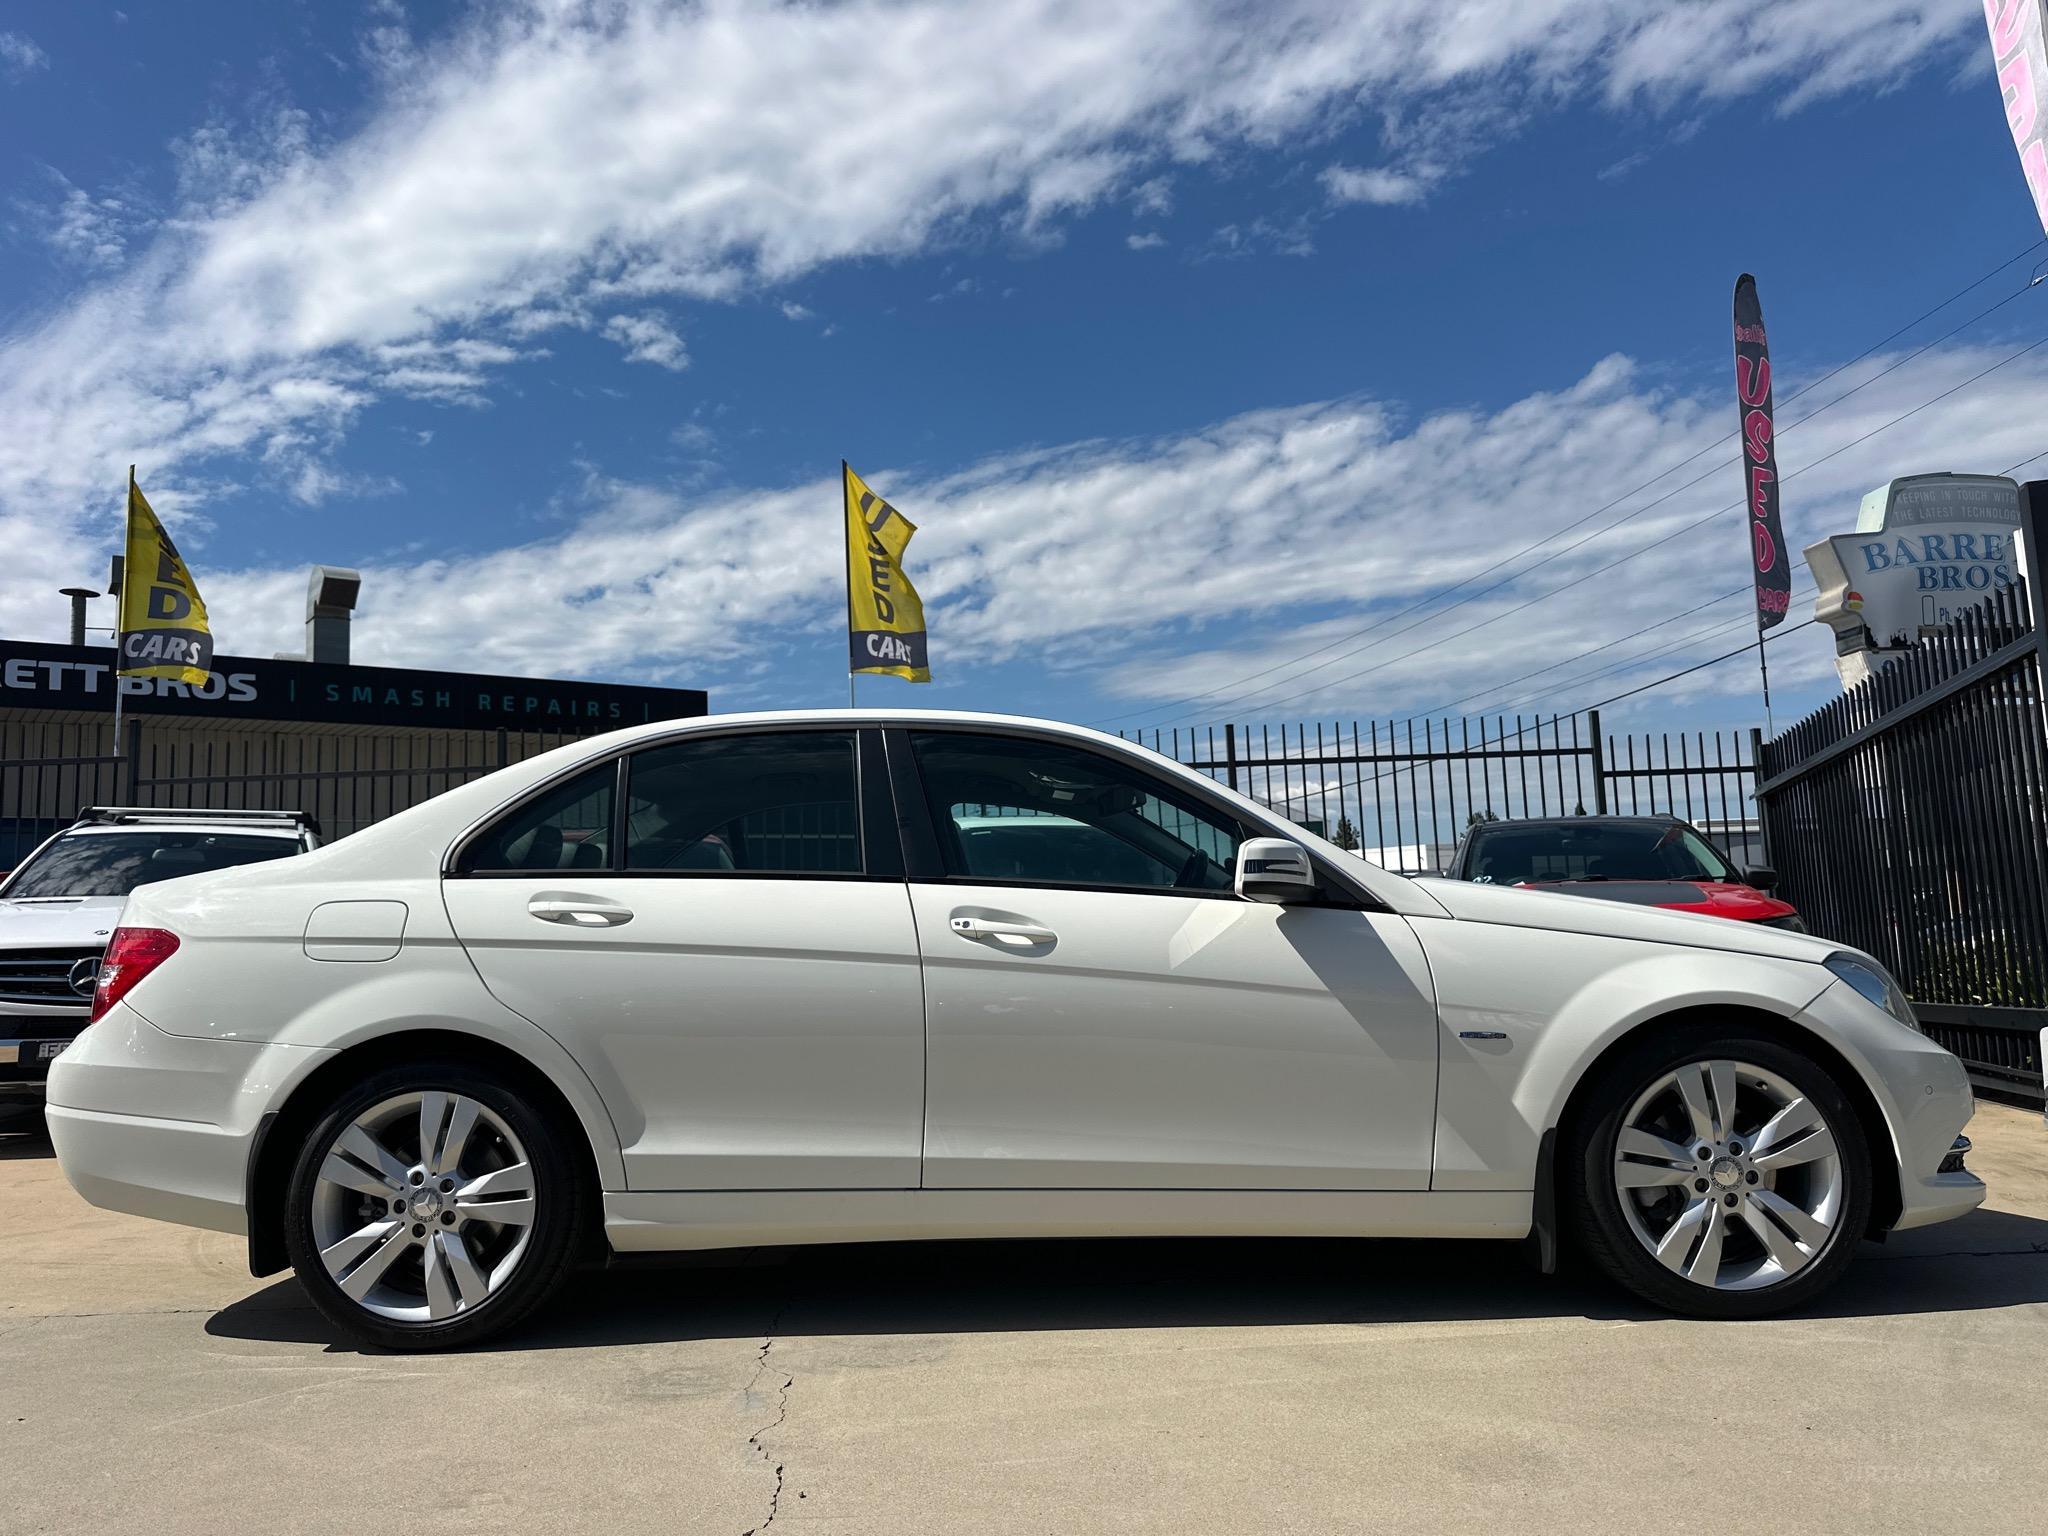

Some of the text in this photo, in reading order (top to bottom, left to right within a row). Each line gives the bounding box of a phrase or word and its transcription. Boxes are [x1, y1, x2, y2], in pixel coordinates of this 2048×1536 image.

[1737, 355, 1776, 573] USED
[1957, 489, 1988, 501] TOUCH
[1993, 490, 2017, 504] WITH
[1894, 508, 1914, 521] THE
[1919, 506, 1954, 520] LATEST
[124, 633, 201, 665] CARS
[0, 658, 110, 693] ETT
[325, 683, 451, 709] SMASH
[478, 694, 621, 719] REPAIRS
